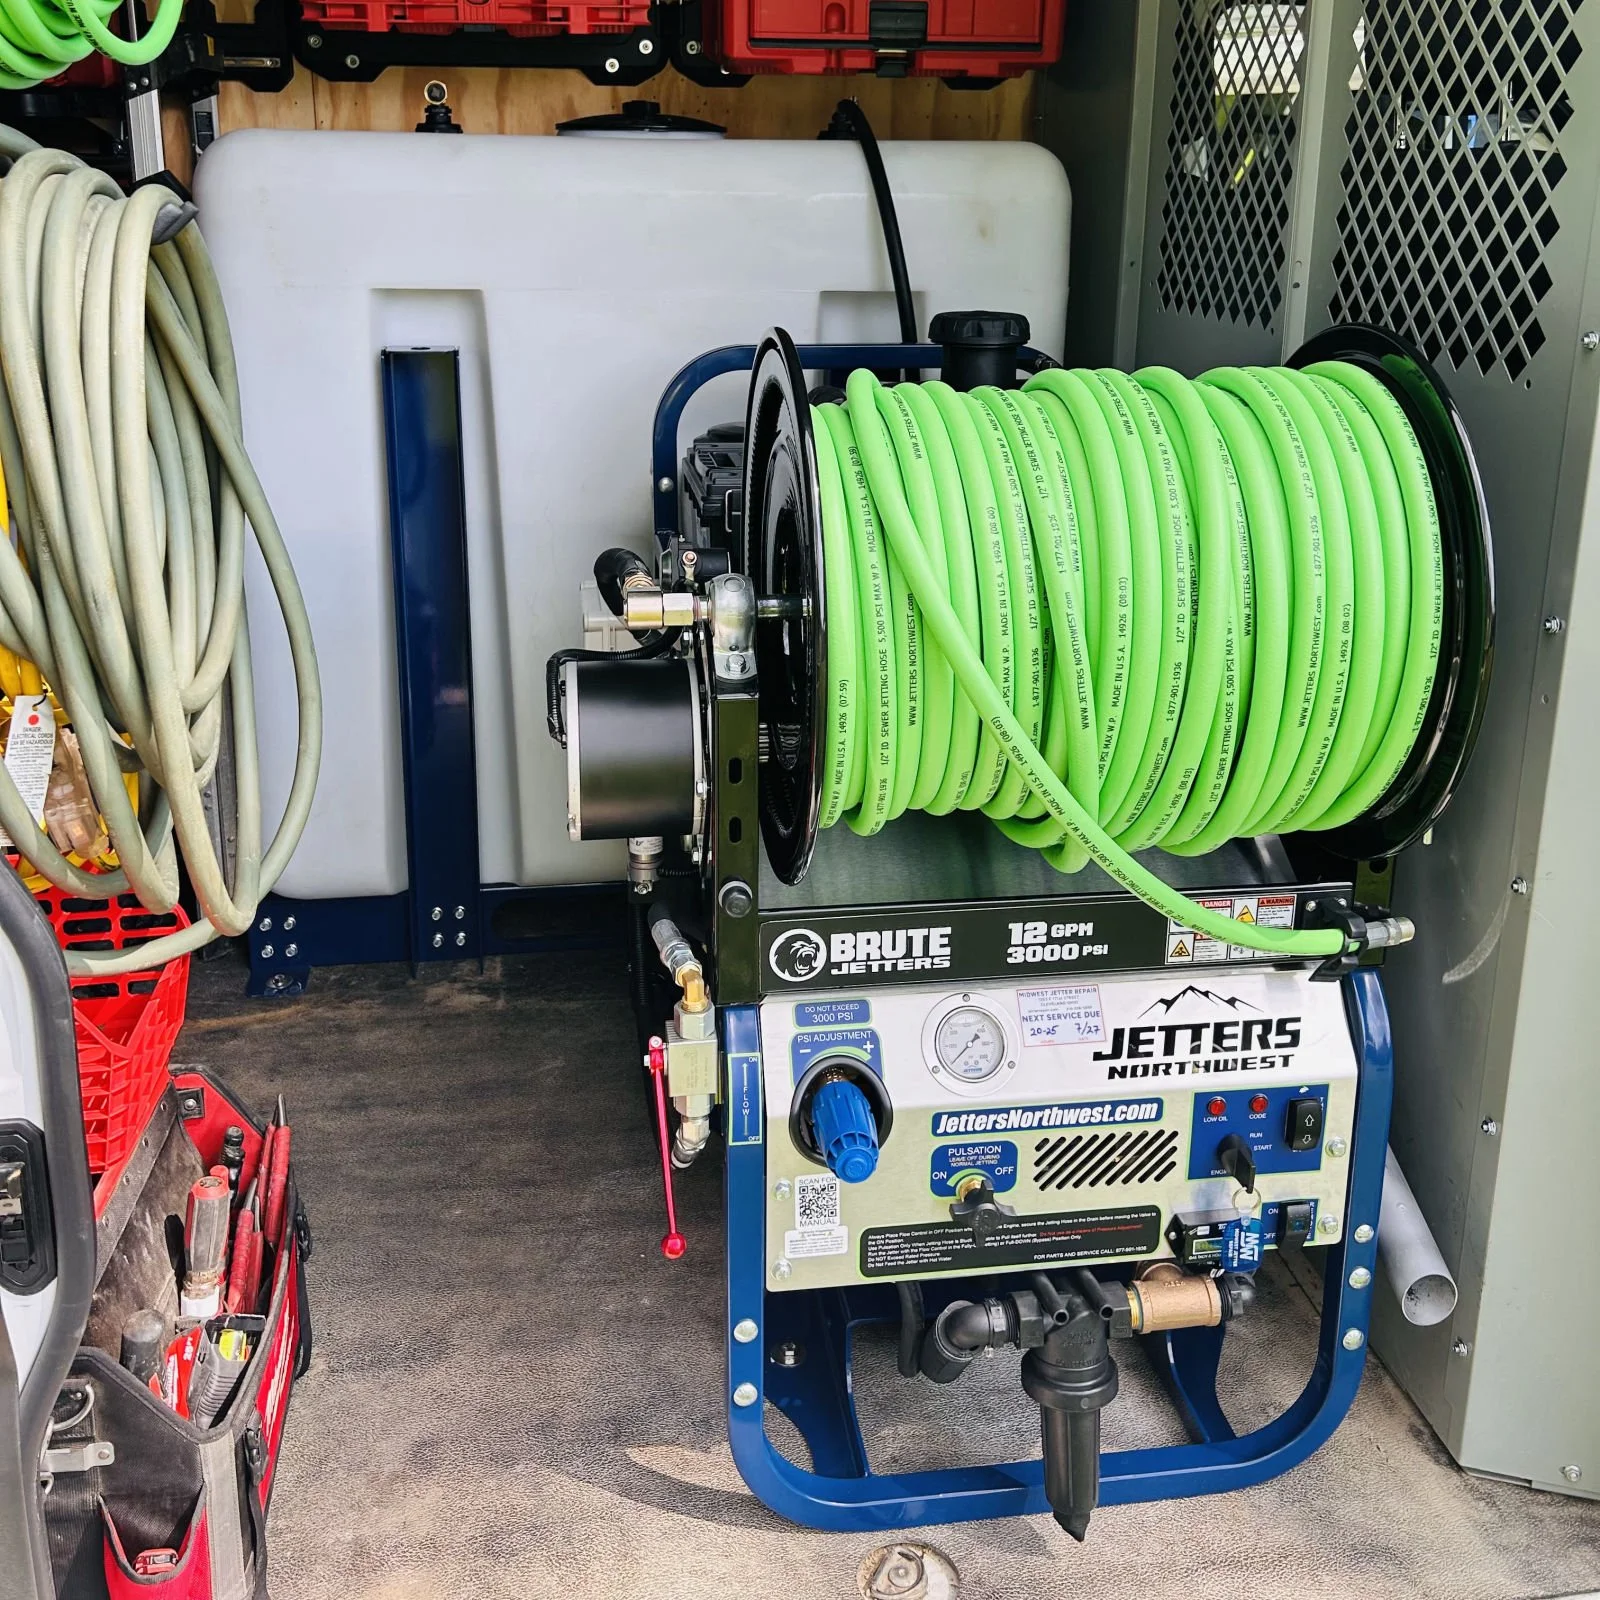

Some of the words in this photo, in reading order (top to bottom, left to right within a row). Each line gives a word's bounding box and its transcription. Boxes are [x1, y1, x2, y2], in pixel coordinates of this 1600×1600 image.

[1150, 419, 1162, 435] MADE
[1284, 419, 1300, 445] JETTING
[1163, 458, 1174, 473] MAX
[1294, 445, 1307, 468] SEWER
[854, 470, 866, 489] 14926
[1166, 474, 1175, 486] PSI
[865, 519, 873, 528] IN
[1173, 515, 1182, 536] HOSE
[866, 529, 877, 553] MADE
[1310, 515, 1322, 577] 1-877-901-1936
[993, 540, 1002, 564] 14926
[1175, 539, 1184, 575] JETTING
[873, 583, 882, 600] MAX
[1118, 576, 1129, 608] (08:03)
[1177, 577, 1185, 608] SEWER
[876, 603, 884, 618] PSI
[1000, 599, 1007, 610] IN
[1000, 611, 1009, 636] MADE
[1119, 614, 1127, 638] 14926
[1177, 613, 1185, 623] ID
[877, 620, 887, 643] 5,500
[906, 592, 917, 666] NORTHWEST.com
[1310, 595, 1322, 668] NORTHWEST.com
[879, 648, 888, 672] HOSE
[1226, 658, 1234, 672] PSI
[1002, 668, 1010, 684] MAX
[1115, 673, 1123, 684] IN
[1226, 674, 1235, 696] 5,500
[839, 679, 849, 707] (07:59)
[880, 674, 889, 708] JETTING
[1002, 686, 1010, 699] PSI
[1111, 685, 1122, 708] MADE
[1166, 661, 1182, 722] 1-877-901-1936
[839, 712, 847, 734] 14926
[1225, 701, 1234, 724] HOSE
[881, 711, 889, 738] SEWER
[1103, 733, 1113, 749] MAX
[1220, 724, 1231, 755] JETTING
[1100, 749, 1109, 762] PSI
[1144, 737, 1169, 792] NORTHWEST.com
[1216, 756, 1227, 780] SEWER
[1205, 900, 1231, 909] DANGER
[1265, 897, 1294, 905] WARNING
[1008, 921, 1047, 945] 12
[1051, 922, 1093, 938] GPM
[831, 927, 951, 962] BRUTE
[1006, 943, 1079, 964] 3000
[1082, 944, 1109, 956] PSI
[831, 956, 950, 975] JETTERS
[1019, 990, 1048, 998] MIDWEST
[812, 1013, 835, 1023] 3000
[837, 1012, 854, 1021] PSI
[832, 1003, 859, 1011] EXCEED
[1022, 1014, 1044, 1022] NEXT
[1046, 1012, 1082, 1021] SERVICE
[1084, 1010, 1100, 1018] DUE
[797, 1035, 811, 1043] PSI
[813, 1030, 872, 1042] ADJUSTMENT
[1030, 1025, 1059, 1036] 20-25
[1075, 1021, 1101, 1036] 7/27
[1092, 1016, 1301, 1061] JETTERS
[1107, 1054, 1295, 1080] NORTHWEST
[742, 1086, 750, 1116] FLOW
[936, 1102, 1158, 1134] JettersNorthwest.com
[948, 1145, 1001, 1156] PULSATION
[932, 1171, 947, 1180] ON
[995, 1166, 1014, 1176] OFF
[799, 1178, 819, 1186] SCAN
[800, 1218, 837, 1227] MANUAL
